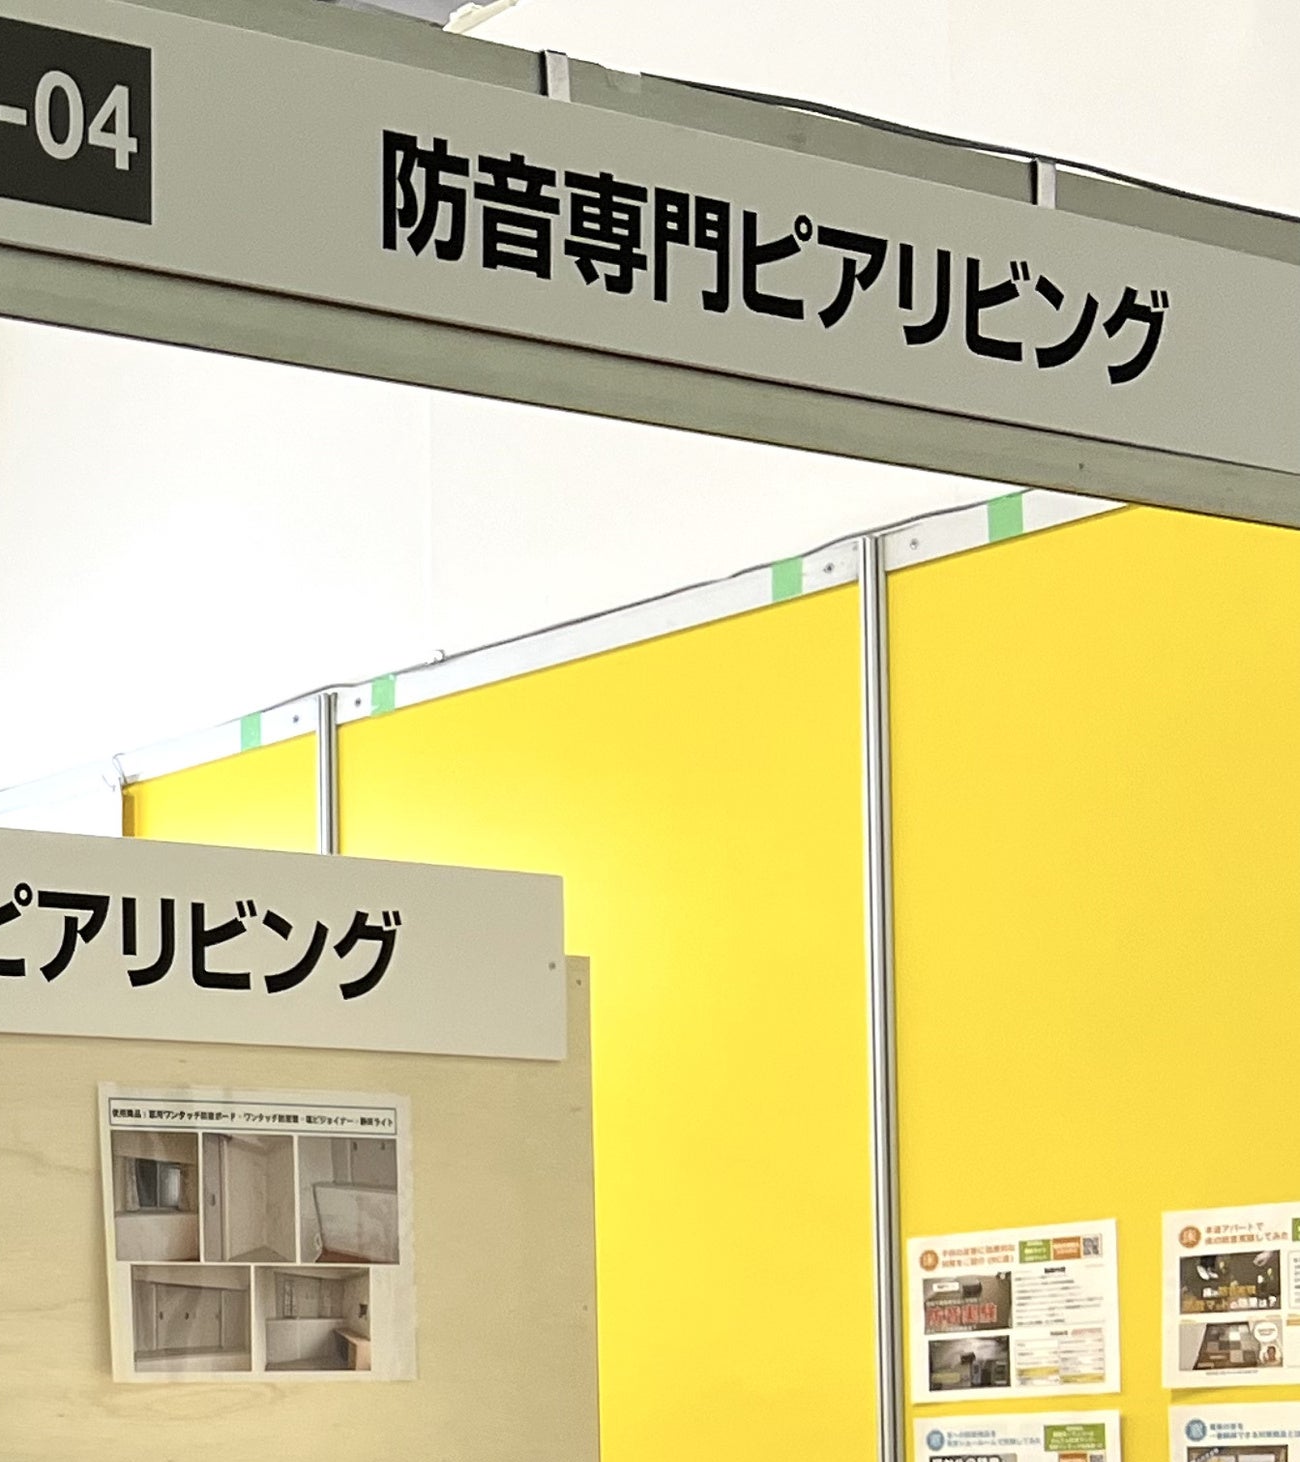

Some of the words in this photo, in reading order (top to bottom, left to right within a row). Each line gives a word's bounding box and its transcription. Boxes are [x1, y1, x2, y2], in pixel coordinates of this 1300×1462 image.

[382, 129, 1170, 385] 防音専門ピアリビング
